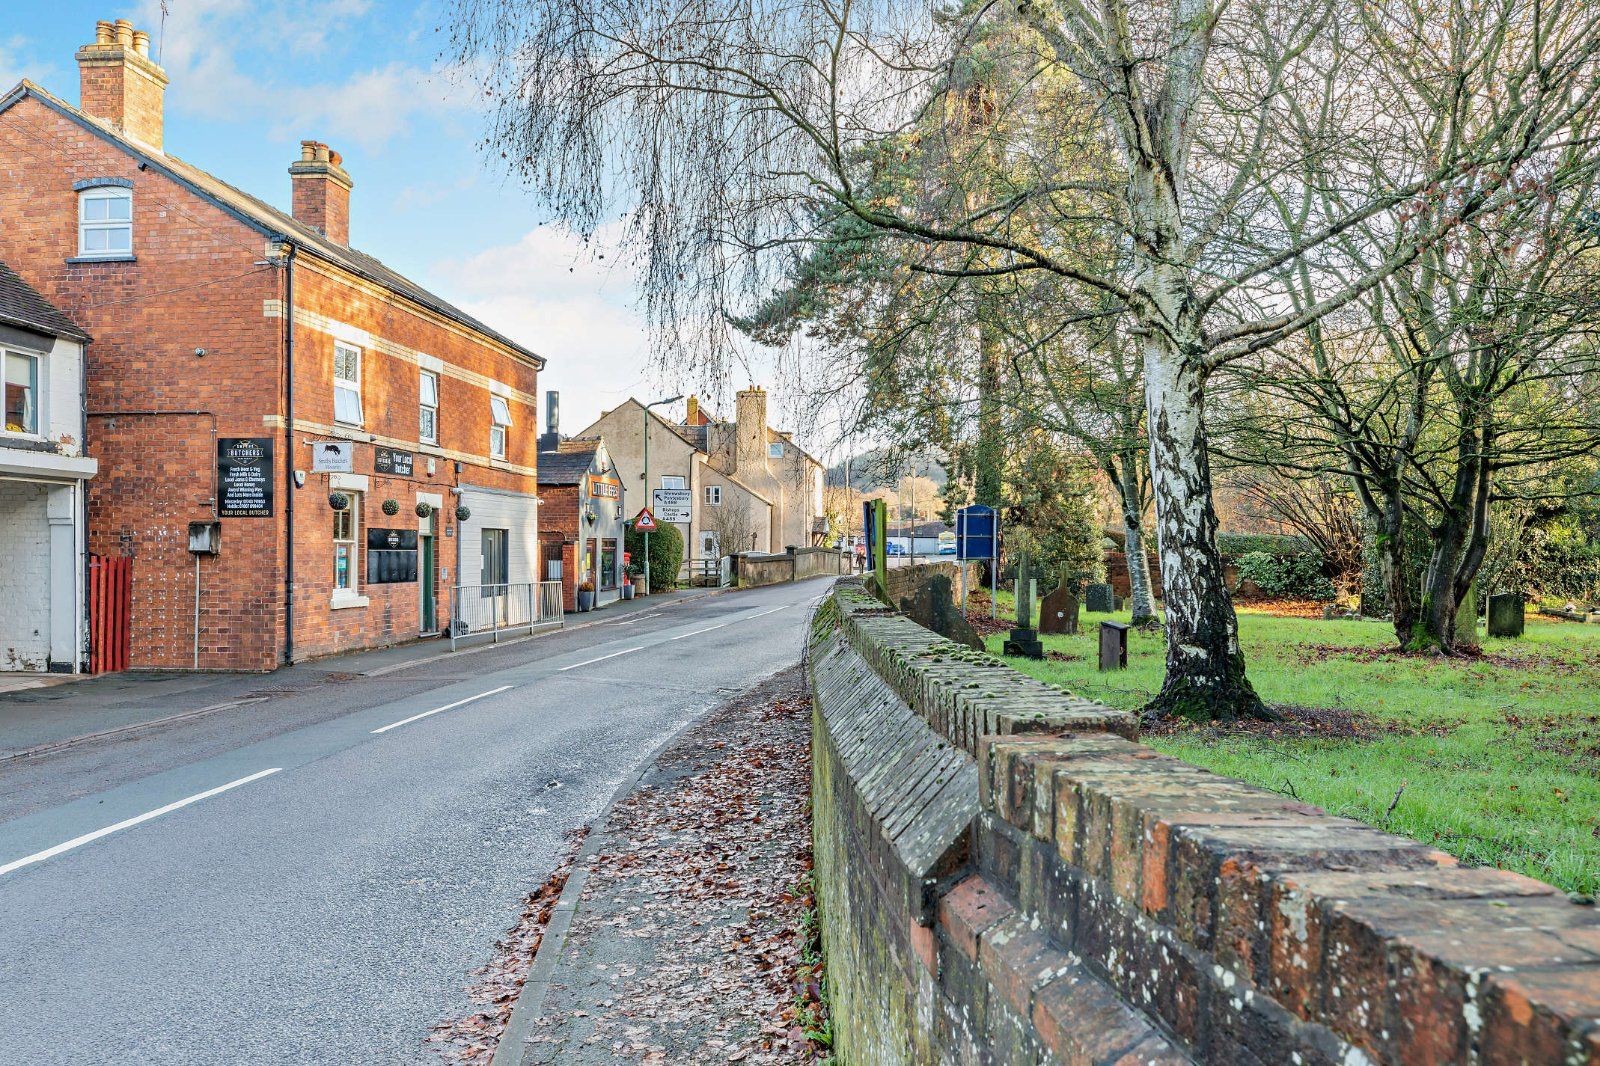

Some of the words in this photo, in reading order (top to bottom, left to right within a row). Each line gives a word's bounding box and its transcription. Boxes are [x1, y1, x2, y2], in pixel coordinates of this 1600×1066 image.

[392, 452, 402, 462] Your
[402, 455, 412, 464] Local
[395, 463, 410, 474] Butcher
[592, 482, 608, 496] LITTLE
